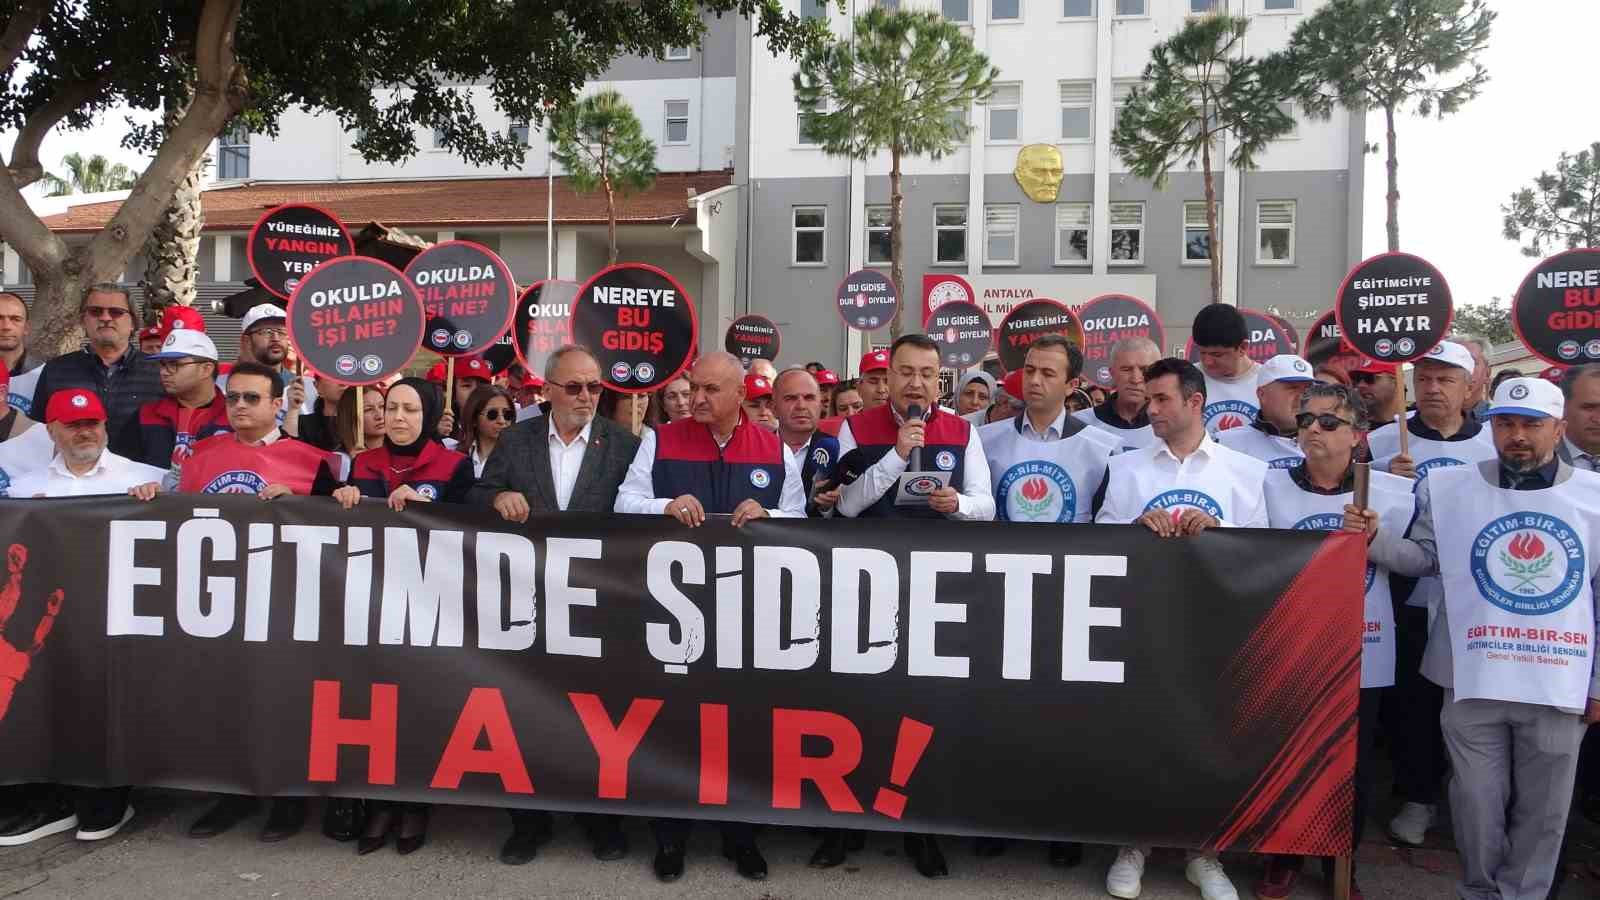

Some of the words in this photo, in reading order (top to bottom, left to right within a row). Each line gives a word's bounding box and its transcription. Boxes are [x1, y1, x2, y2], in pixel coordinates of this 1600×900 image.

[267, 222, 341, 238] YÜREĞİMİZ
[265, 237, 339, 255] YANGIN
[415, 264, 496, 285] OKULDA
[1353, 277, 1432, 290] EĞİTİMCİYE
[1537, 270, 1600, 289] NERE
[310, 280, 402, 308] OKULDA
[593, 286, 676, 307] NEREYE
[848, 283, 859, 292] BU
[983, 288, 1034, 299] ANTALYA
[425, 304, 446, 321] Şİ
[451, 300, 489, 317] NE?
[528, 303, 571, 318] OKUL
[1358, 293, 1429, 310] ŞİDDETE
[310, 299, 404, 328] SİLAHIN
[616, 307, 650, 328] BU
[937, 317, 949, 327] BU
[1008, 315, 1069, 330] YÜREĞİMİZ
[1083, 314, 1150, 331] OKULDA
[354, 319, 398, 341] NE?
[1357, 315, 1432, 334] HAYIR
[601, 330, 664, 355] GİDİŞ
[107, 508, 602, 657] EĞİTİMDE
[645, 540, 1128, 683] ŞİDDETE
[307, 680, 934, 820] HAYIR!
